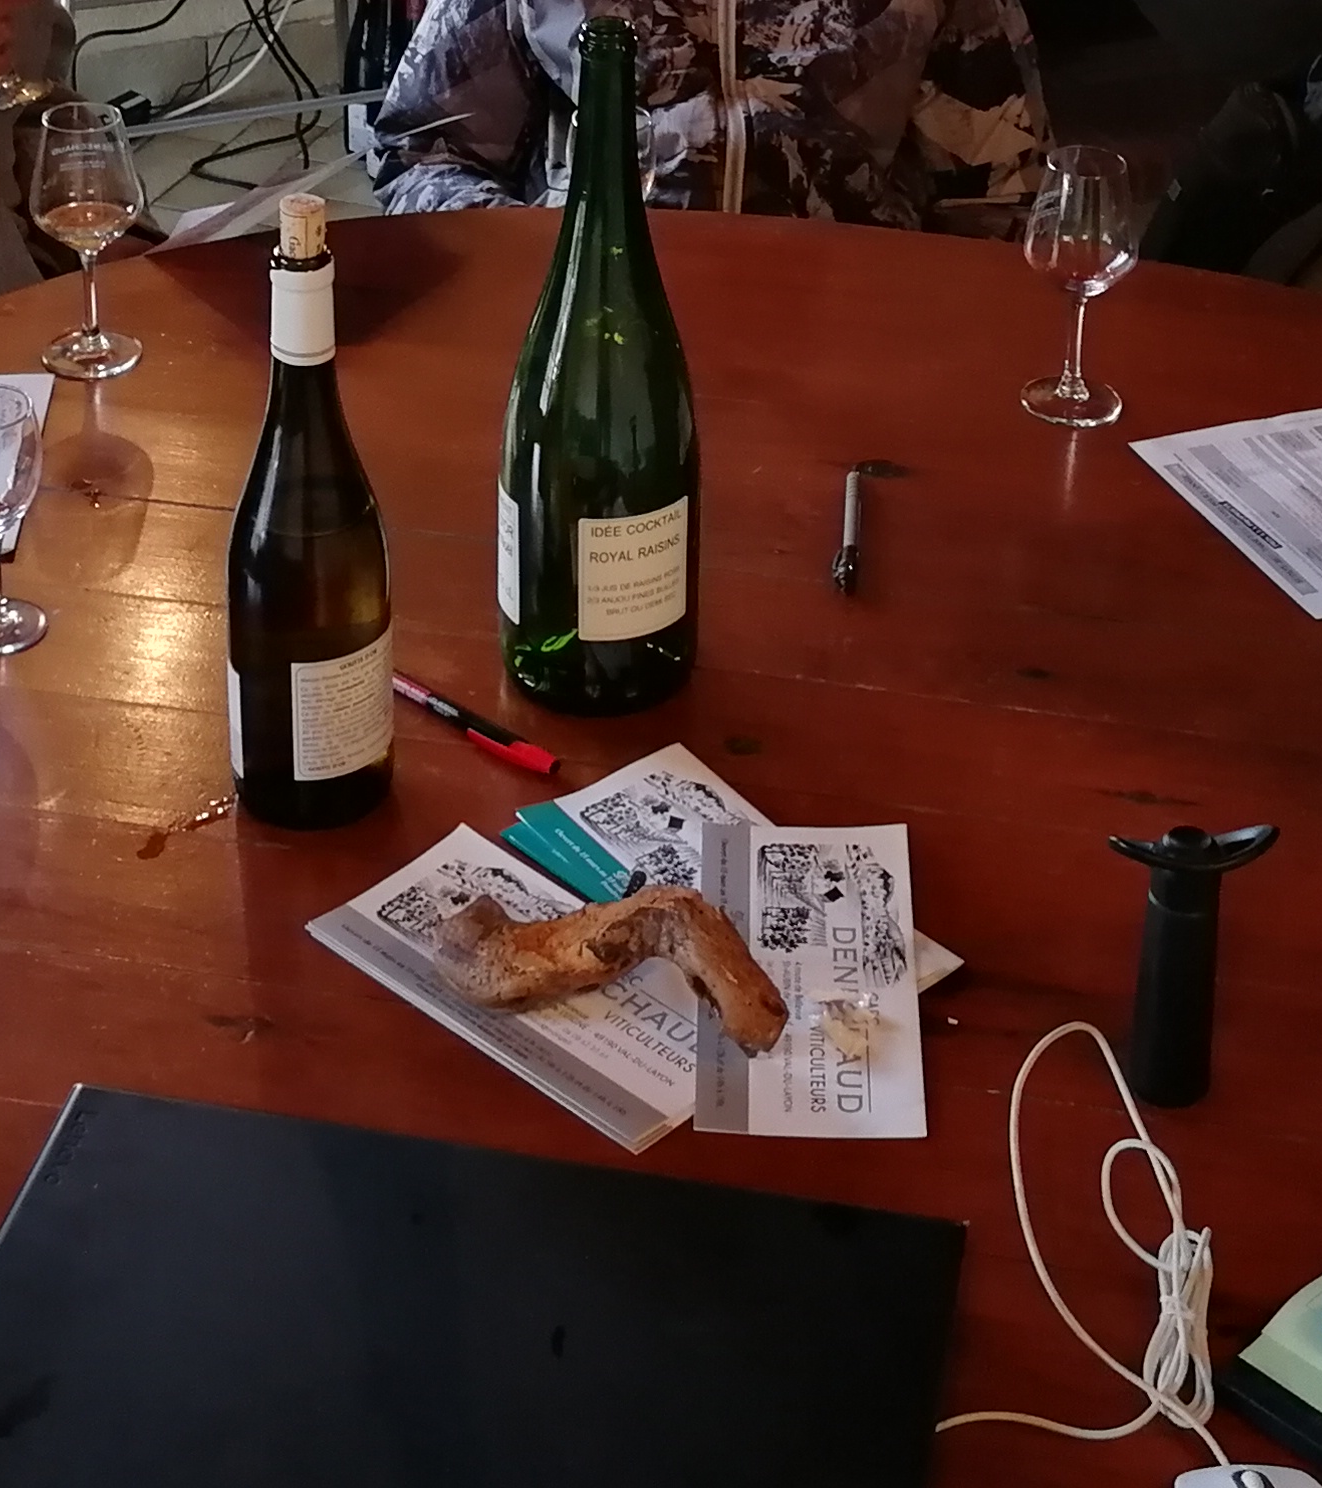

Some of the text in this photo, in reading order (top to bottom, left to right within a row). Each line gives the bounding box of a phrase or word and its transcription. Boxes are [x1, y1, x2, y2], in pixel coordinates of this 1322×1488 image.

[589, 533, 681, 564] ROYAL RAISINS
[626, 510, 682, 537] COCKTAIL
[603, 1010, 697, 1074] VITICULTEURS
[832, 926, 864, 1114] DENAUD
[616, 1044, 676, 1088] VAL-DU-LAYON
[809, 1025, 827, 1114] VITICULTEURS
